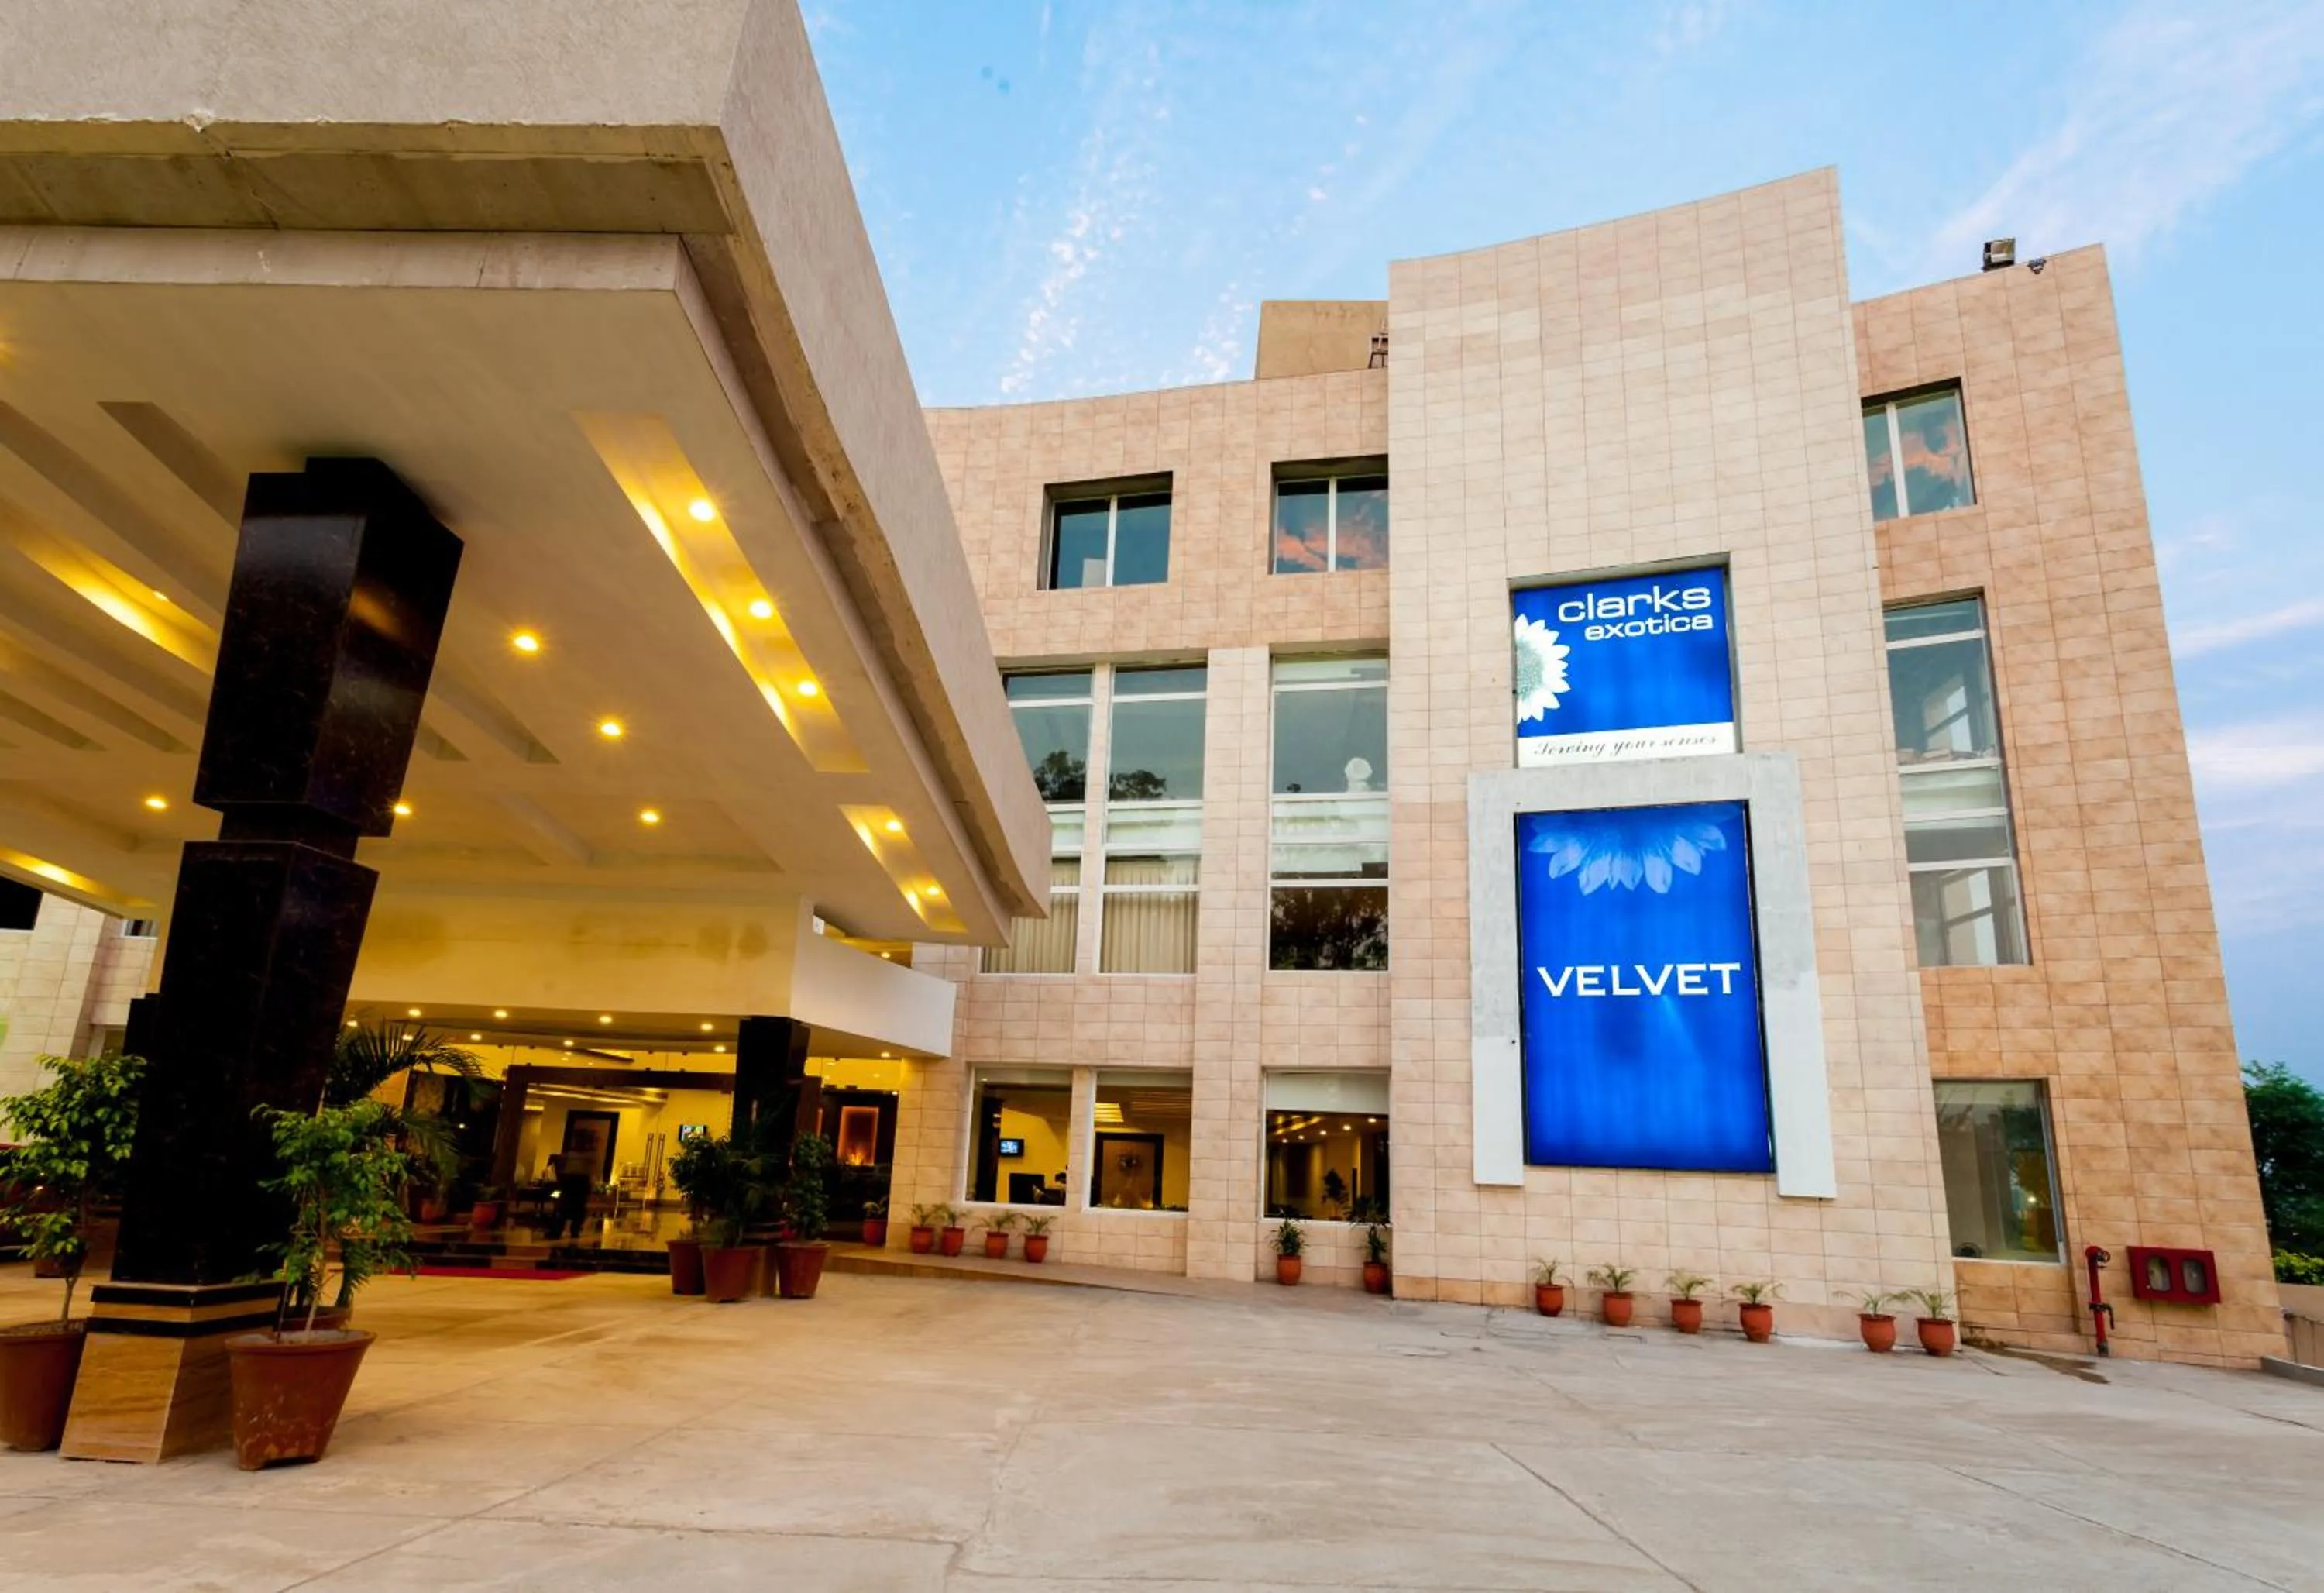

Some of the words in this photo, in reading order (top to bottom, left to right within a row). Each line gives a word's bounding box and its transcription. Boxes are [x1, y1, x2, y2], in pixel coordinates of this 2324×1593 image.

[1558, 585, 1711, 622] clarks
[1584, 614, 1713, 640] exotica
[1611, 740, 1655, 757] your
[1537, 962, 1741, 997] VELVET
